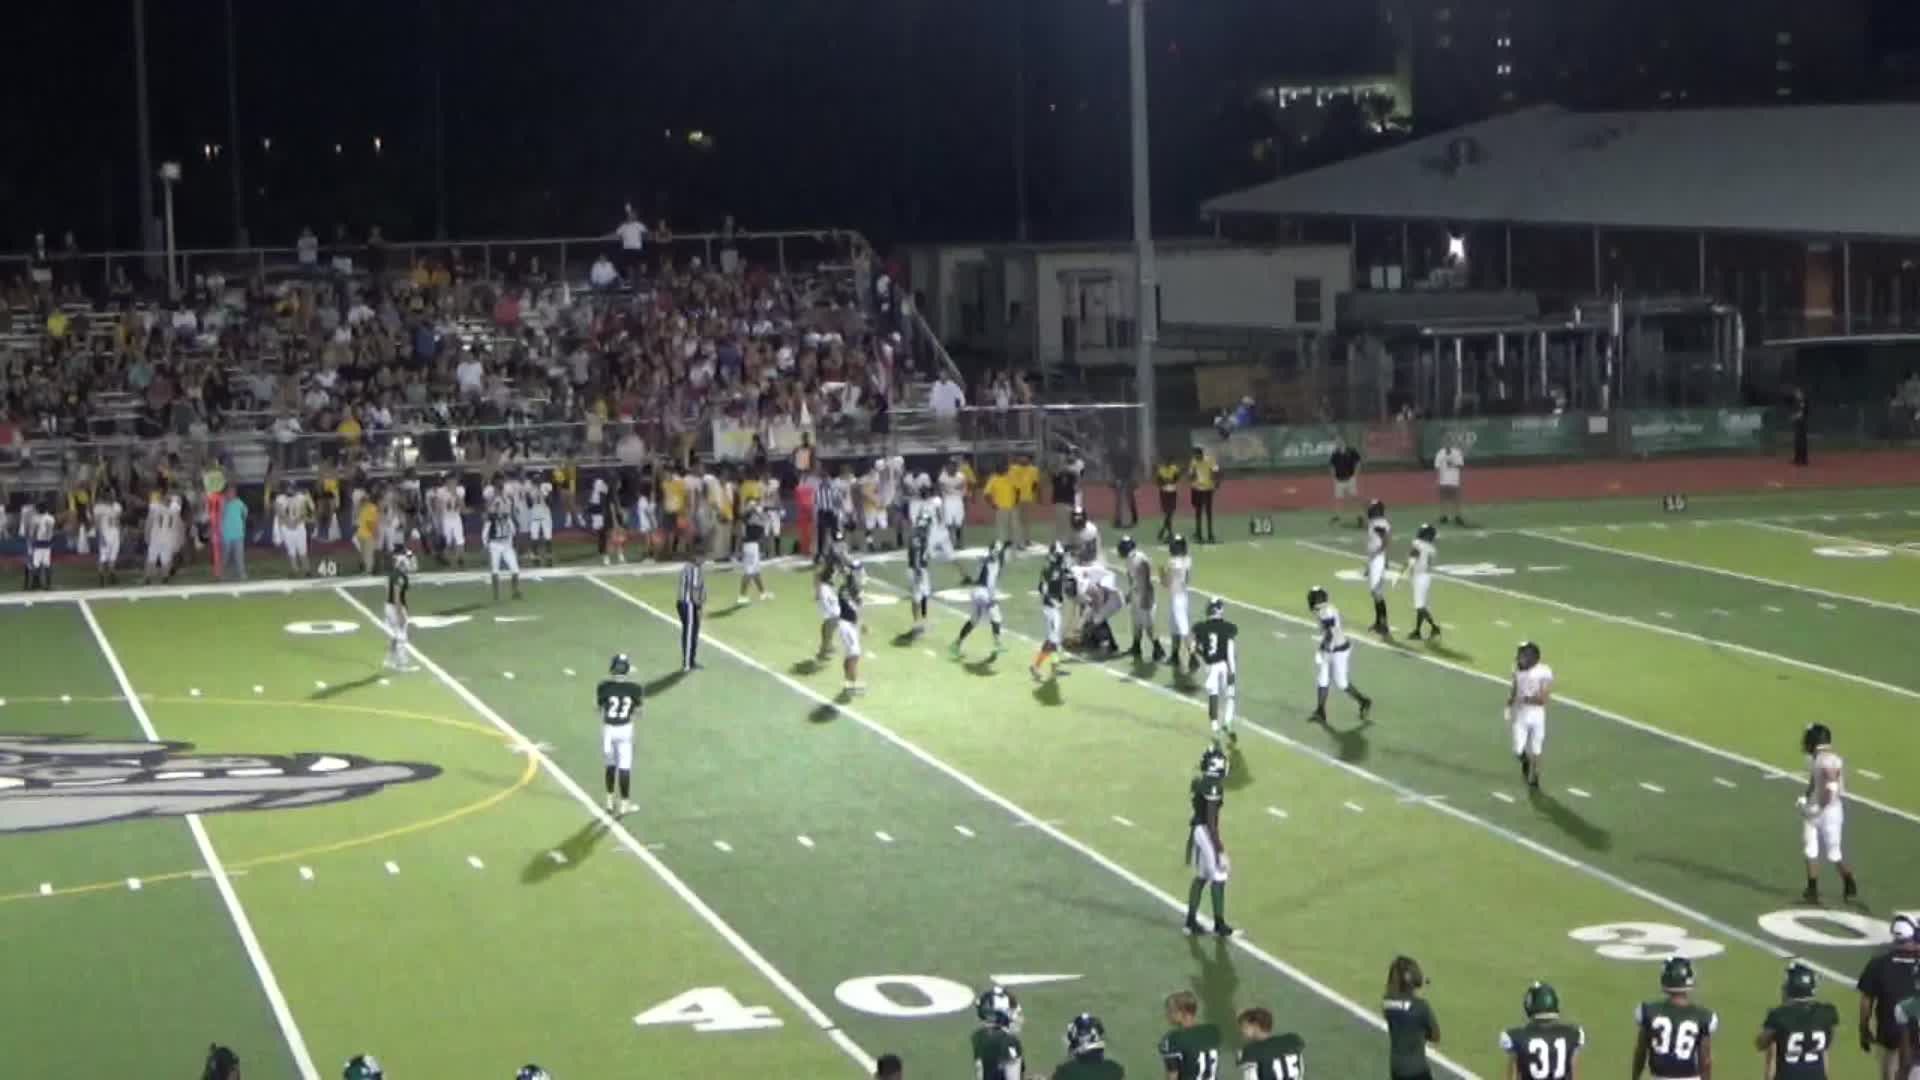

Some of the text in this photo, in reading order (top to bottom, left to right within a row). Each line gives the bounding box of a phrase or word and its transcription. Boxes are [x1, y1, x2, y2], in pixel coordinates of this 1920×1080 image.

[319, 559, 337, 576] 40
[1208, 632, 1218, 656] 3
[608, 695, 632, 719] 23
[1651, 1016, 1699, 1060] 36
[1528, 1037, 1567, 1080] 31
